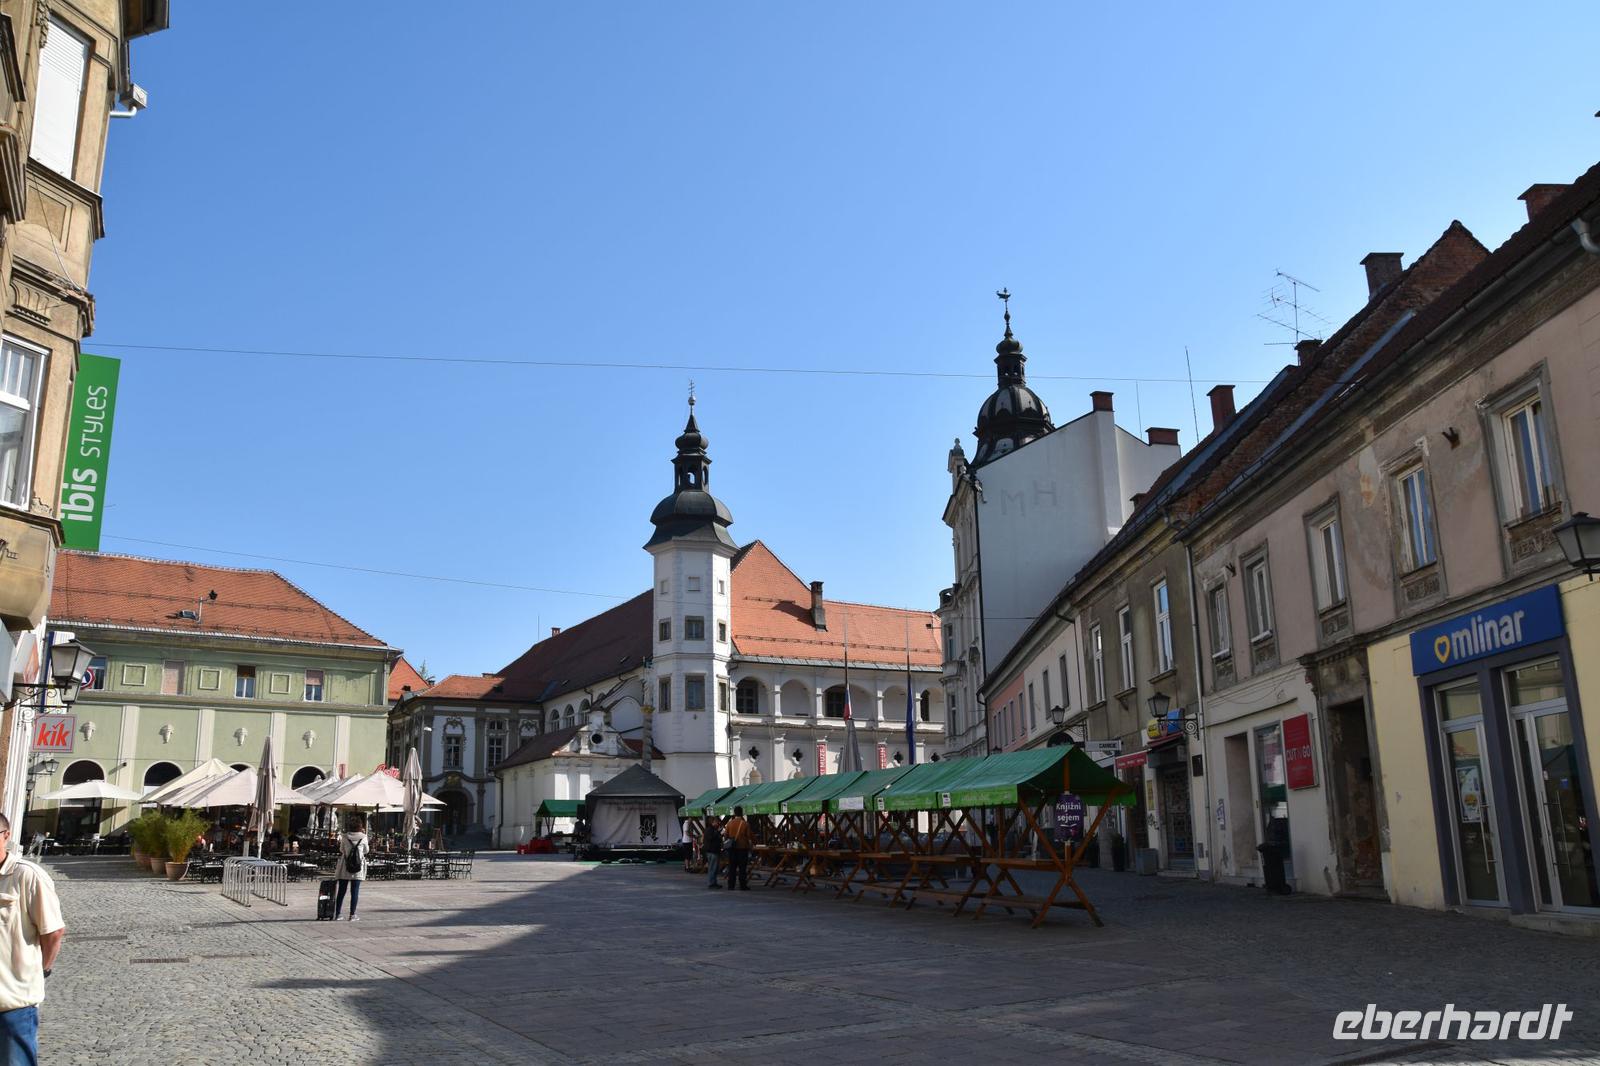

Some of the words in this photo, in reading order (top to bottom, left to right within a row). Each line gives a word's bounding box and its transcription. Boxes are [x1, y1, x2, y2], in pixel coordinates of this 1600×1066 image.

[60, 468, 98, 522] ibis
[1451, 610, 1524, 660] mlinar
[37, 719, 70, 746] kik
[1056, 802, 1081, 812] Knjižni
[1057, 814, 1080, 823] sejem
